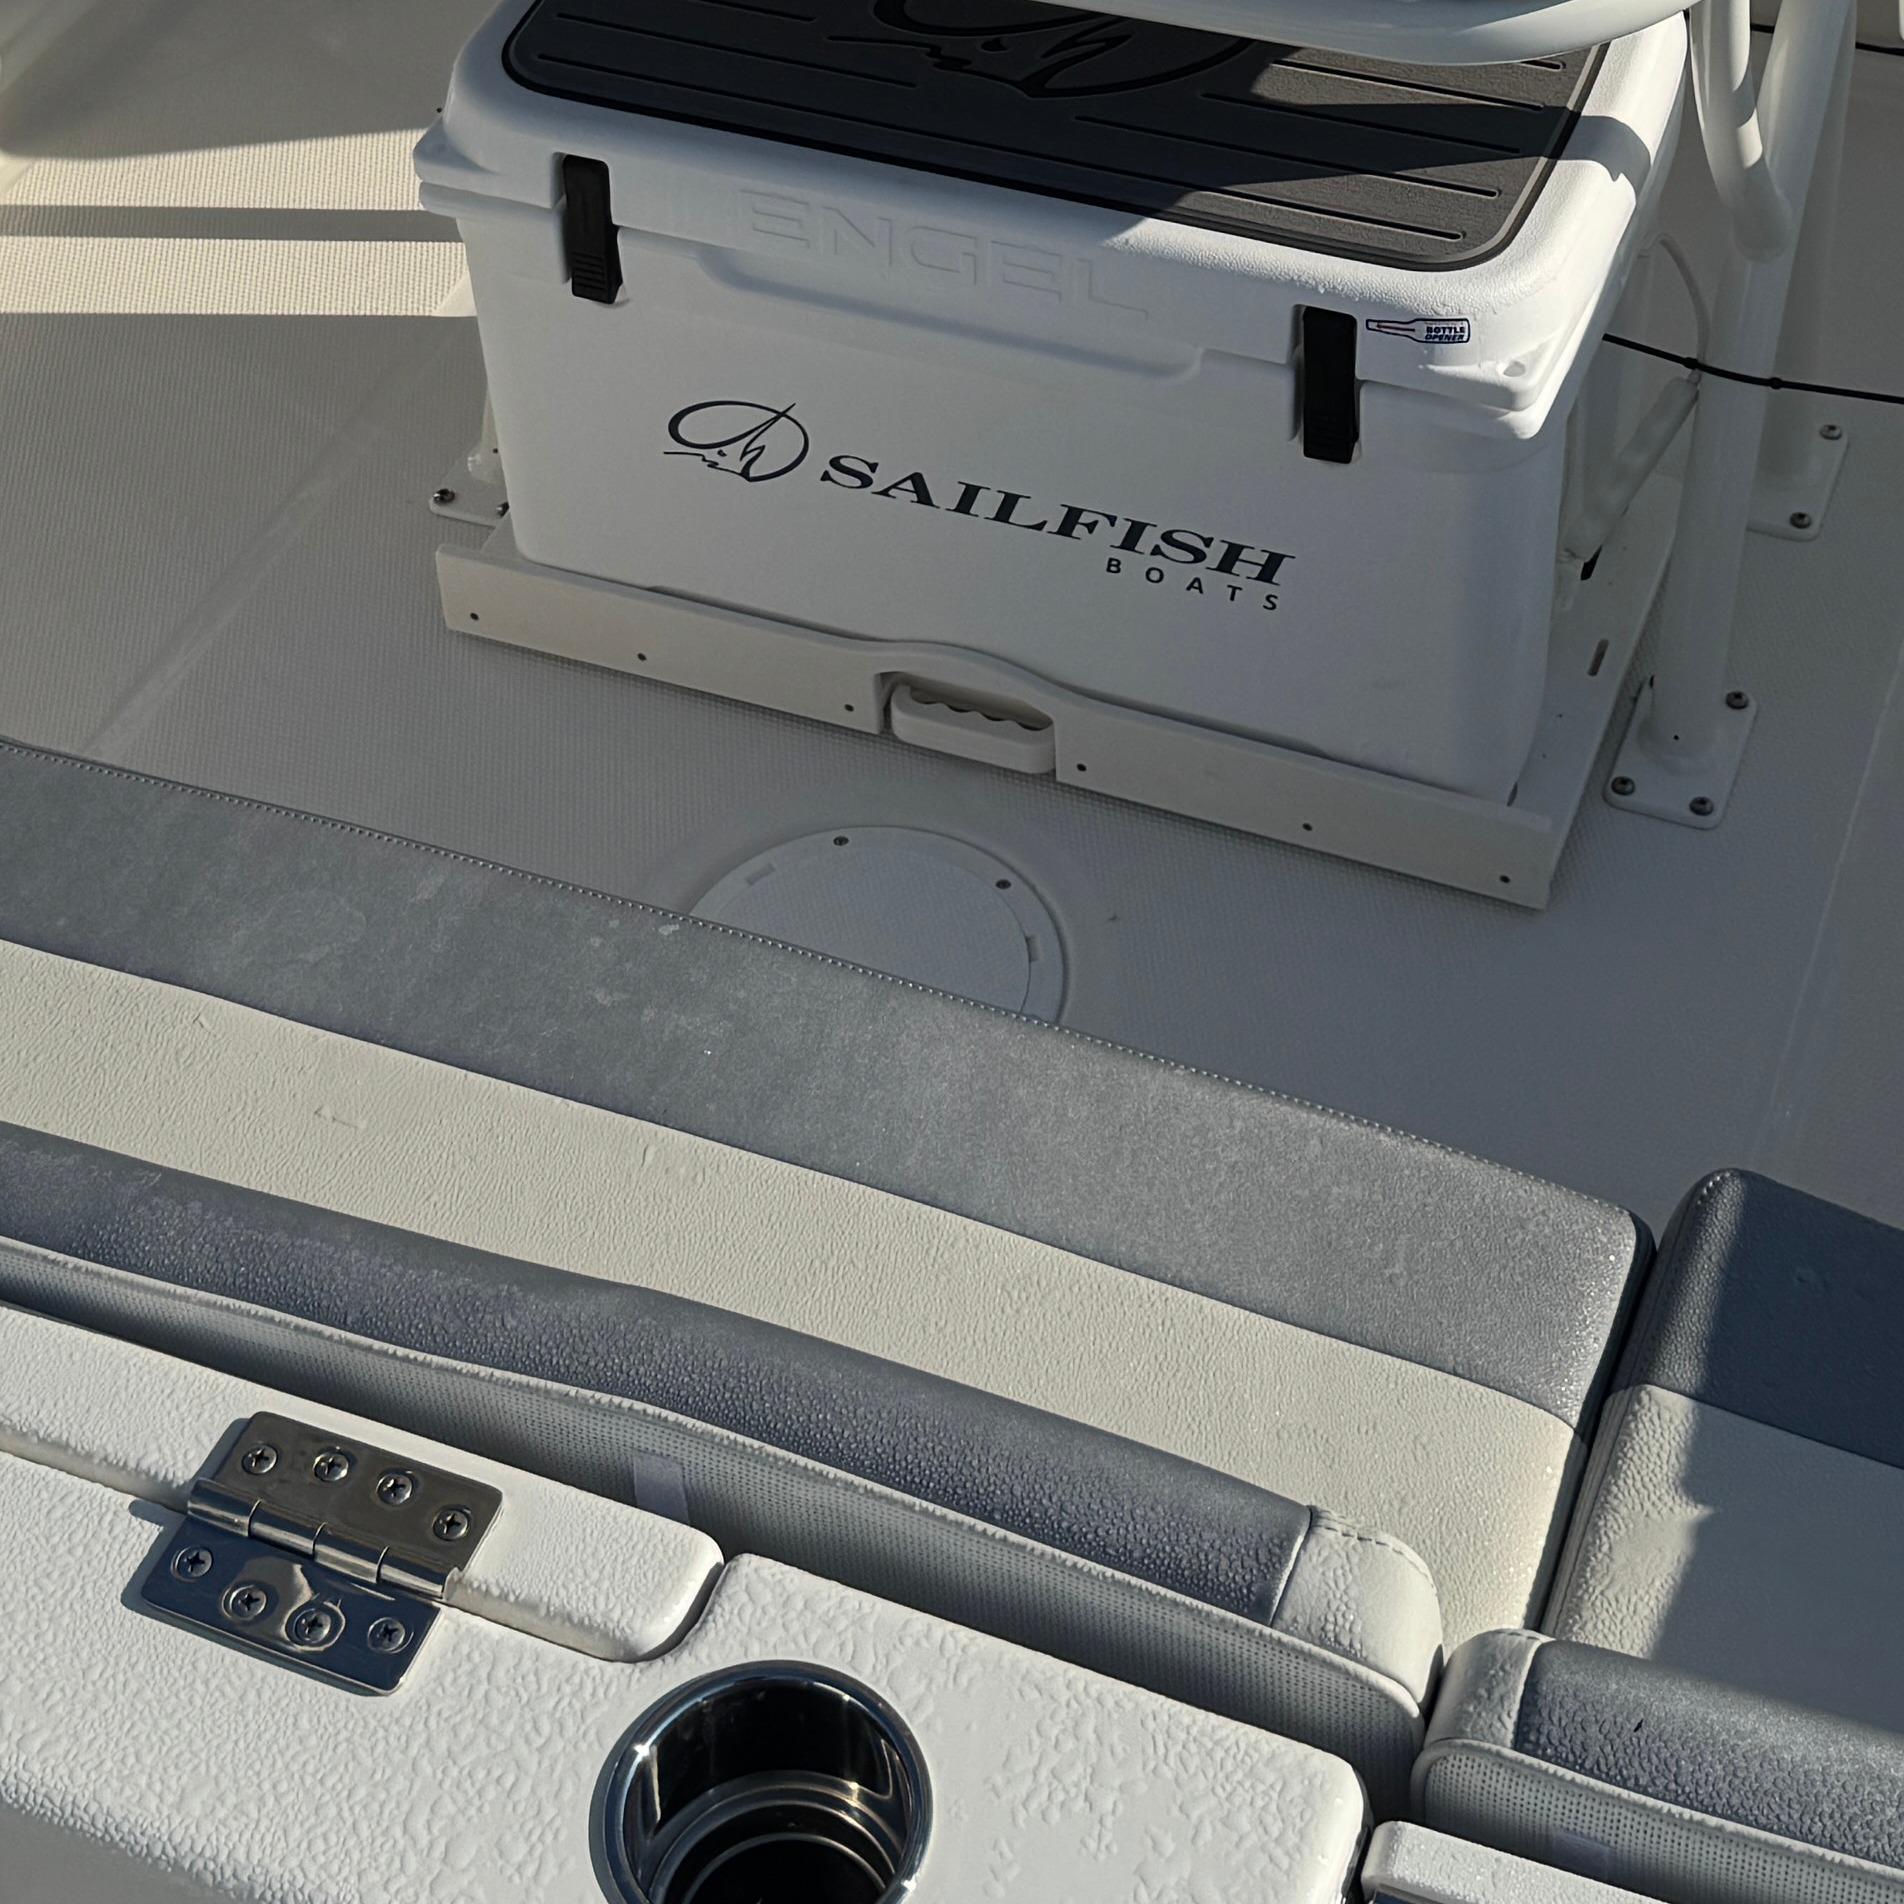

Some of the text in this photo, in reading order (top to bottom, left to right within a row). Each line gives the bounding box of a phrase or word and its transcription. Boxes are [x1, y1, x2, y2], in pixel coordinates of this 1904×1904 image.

[741, 188, 1149, 321] ENGEL
[1424, 334, 1465, 342] OPENER
[1426, 326, 1466, 335] BOTTLE
[820, 454, 1296, 586] SAILFISH
[1105, 557, 1280, 611] BOATS
